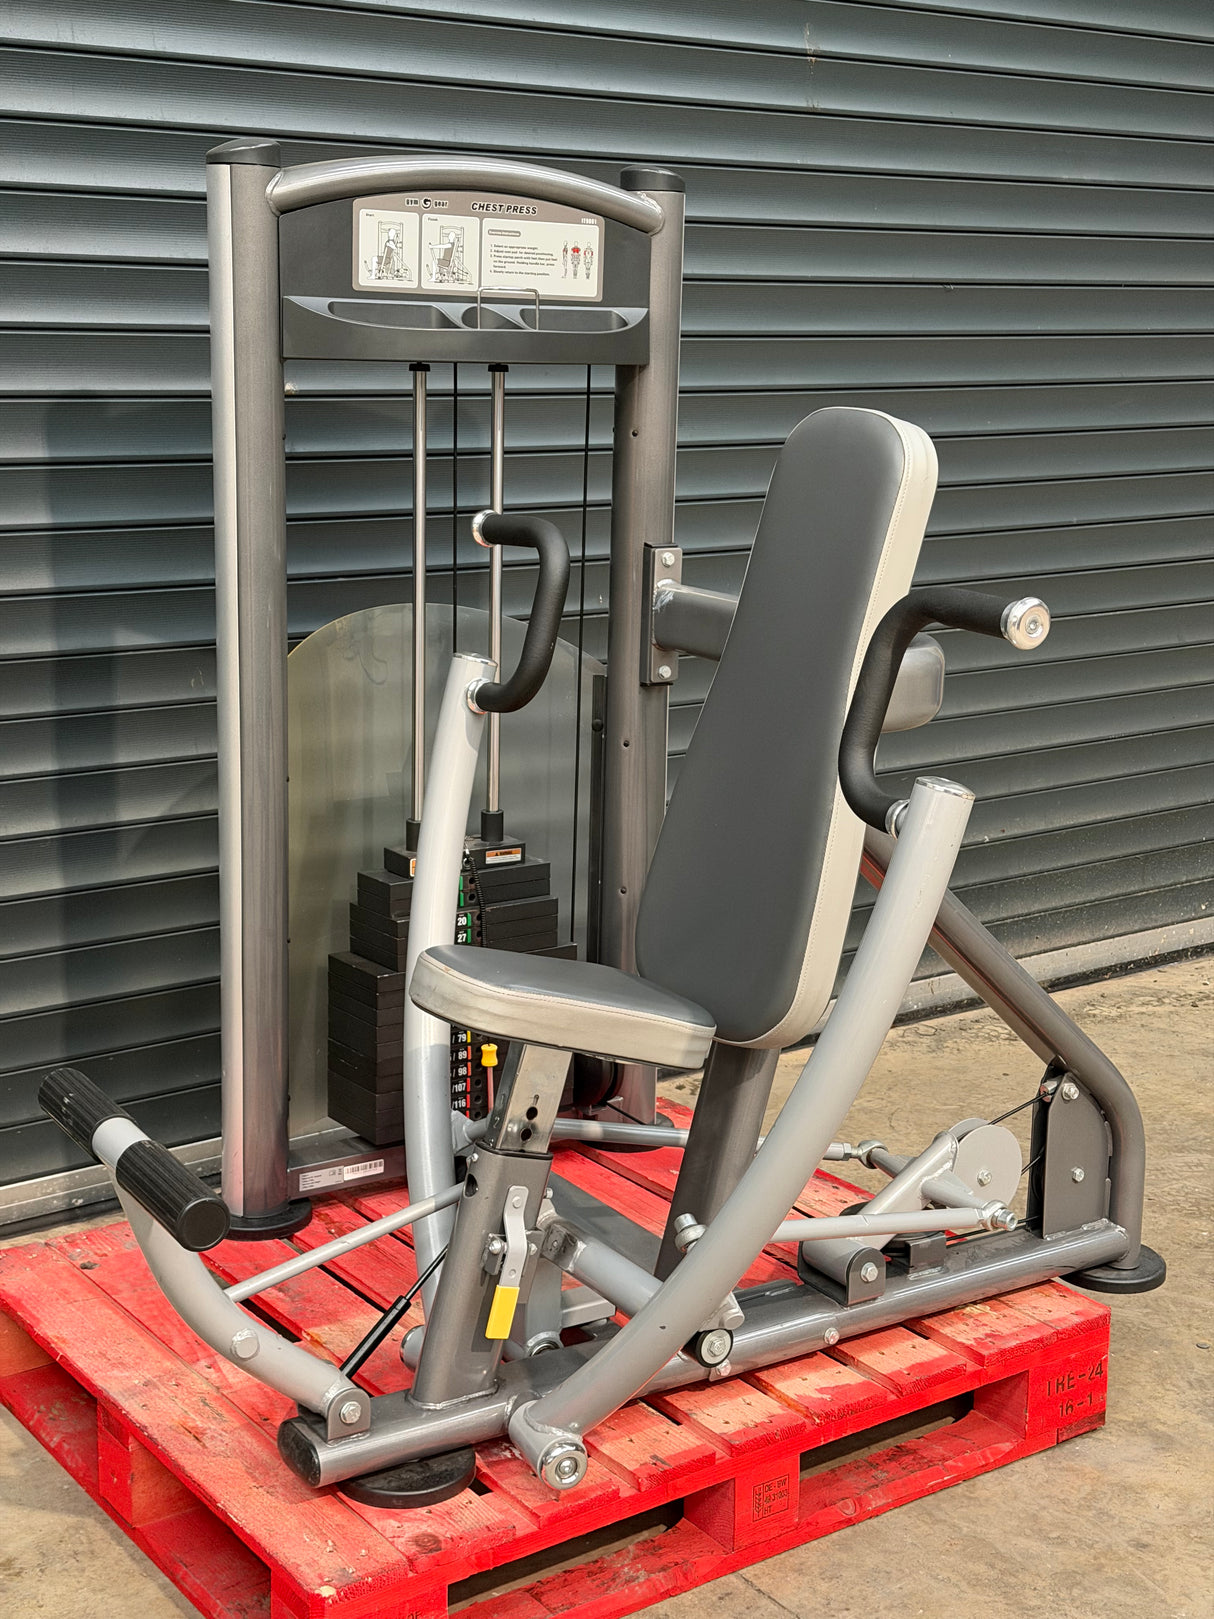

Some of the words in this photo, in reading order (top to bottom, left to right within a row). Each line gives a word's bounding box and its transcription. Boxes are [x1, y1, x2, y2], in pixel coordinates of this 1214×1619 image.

[471, 202, 504, 212] CHEST
[505, 204, 538, 215] PRESS
[457, 916, 467, 926] 20
[457, 933, 467, 943] 27
[458, 1034, 466, 1042] 79
[458, 1051, 467, 1060] 89
[458, 1067, 467, 1075] 98
